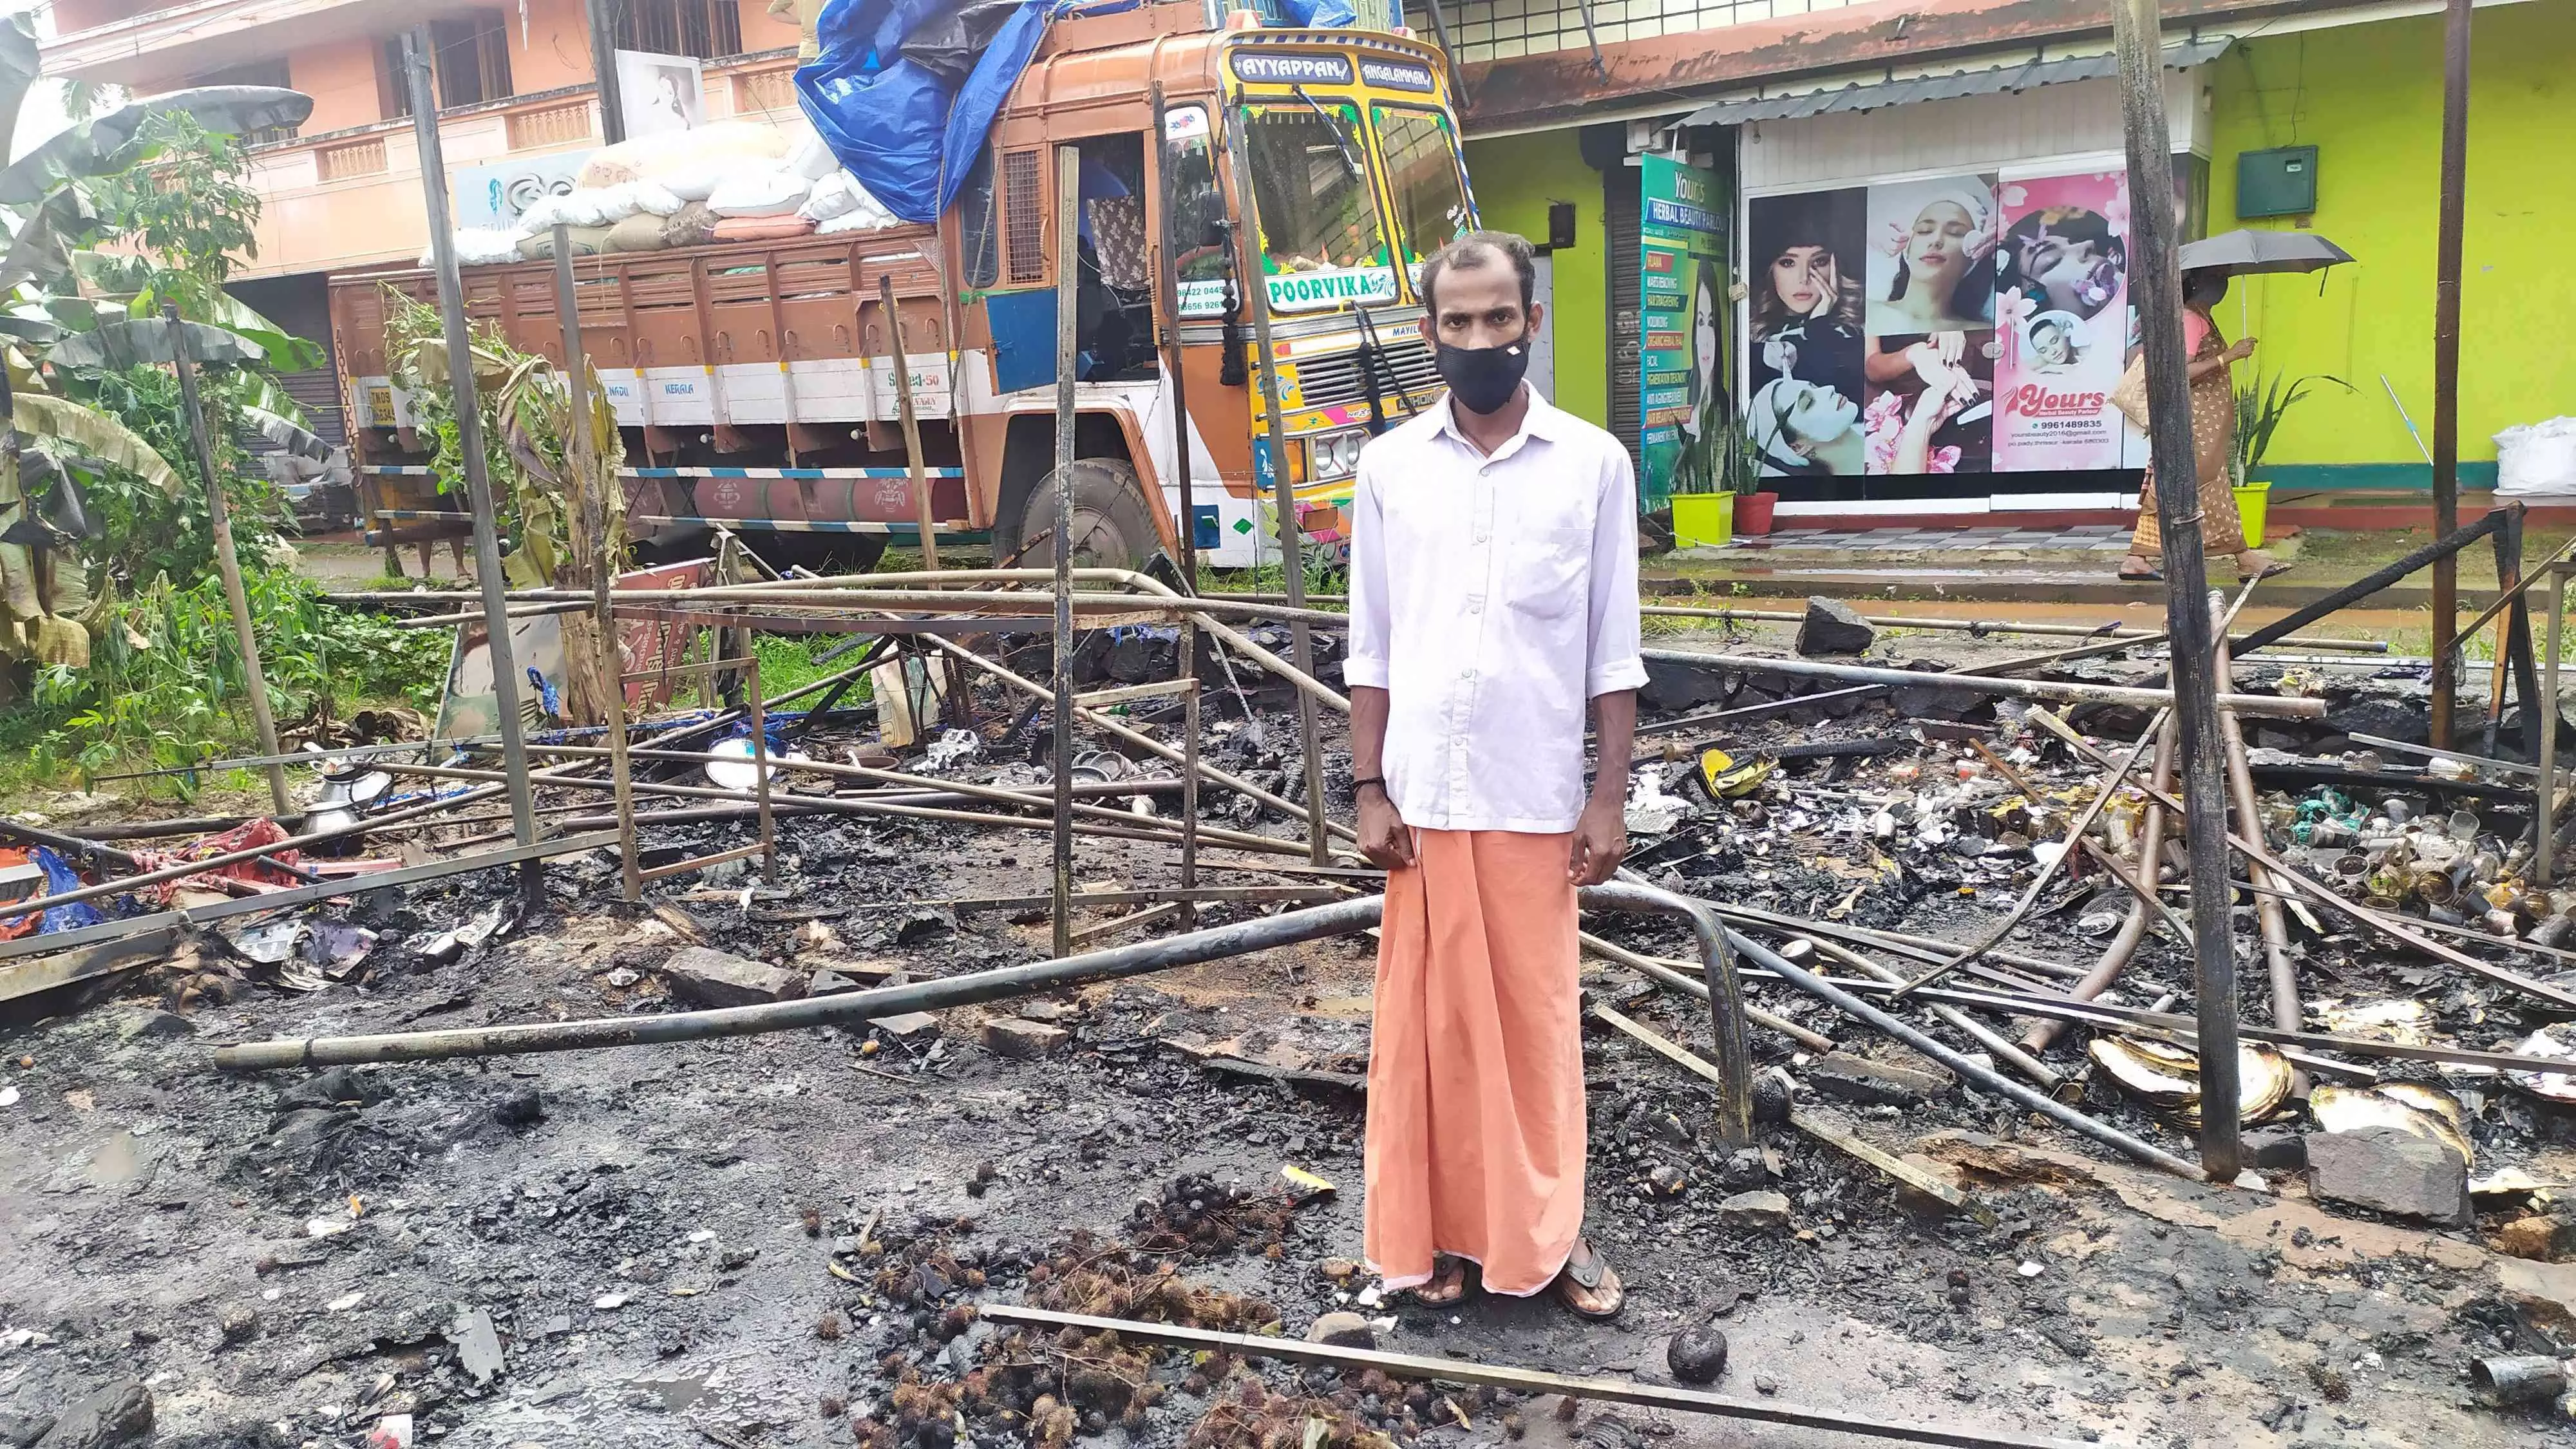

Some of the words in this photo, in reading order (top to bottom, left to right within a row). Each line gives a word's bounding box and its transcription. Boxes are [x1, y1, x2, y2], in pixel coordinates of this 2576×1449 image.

[1653, 202, 1678, 223] HERBAL
[1680, 206, 1701, 226] BEAUTY
[1269, 275, 1372, 303] POORVIKA
[665, 384, 694, 395] KERALA
[1399, 393, 1434, 410] AHOK
[2018, 384, 2105, 417] Yours
[2041, 420, 2103, 430] 9961489835
